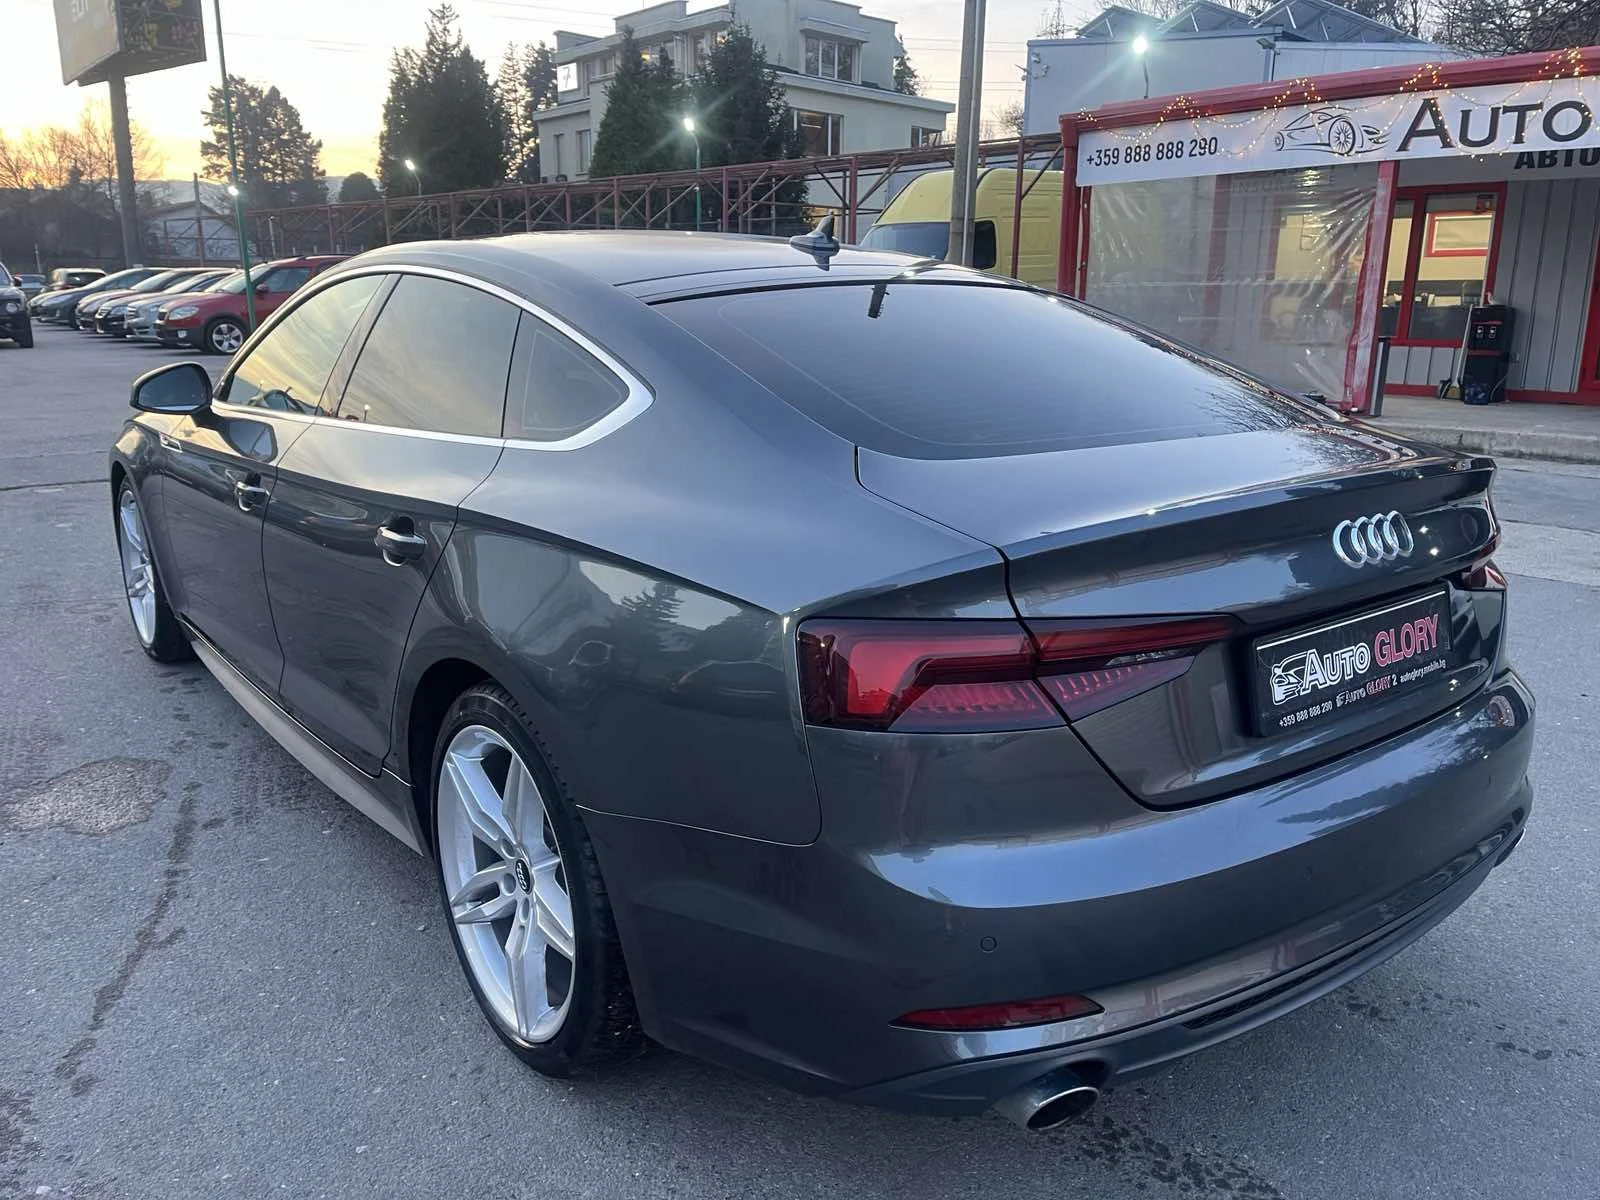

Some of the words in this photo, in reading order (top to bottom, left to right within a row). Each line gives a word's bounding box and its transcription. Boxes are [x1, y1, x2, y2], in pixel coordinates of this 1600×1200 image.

[1086, 148, 1120, 167] +359
[1124, 144, 1151, 164] 888
[1156, 140, 1184, 160] 888
[1188, 136, 1218, 157] 290
[1396, 97, 1593, 152] AUTO
[1374, 613, 1439, 667] GLORY
[1279, 713, 1296, 728] +359
[1296, 709, 1309, 722] 888
[1309, 704, 1321, 717] 888
[1366, 675, 1391, 696] GLORY
[1391, 673, 1398, 686] 2
